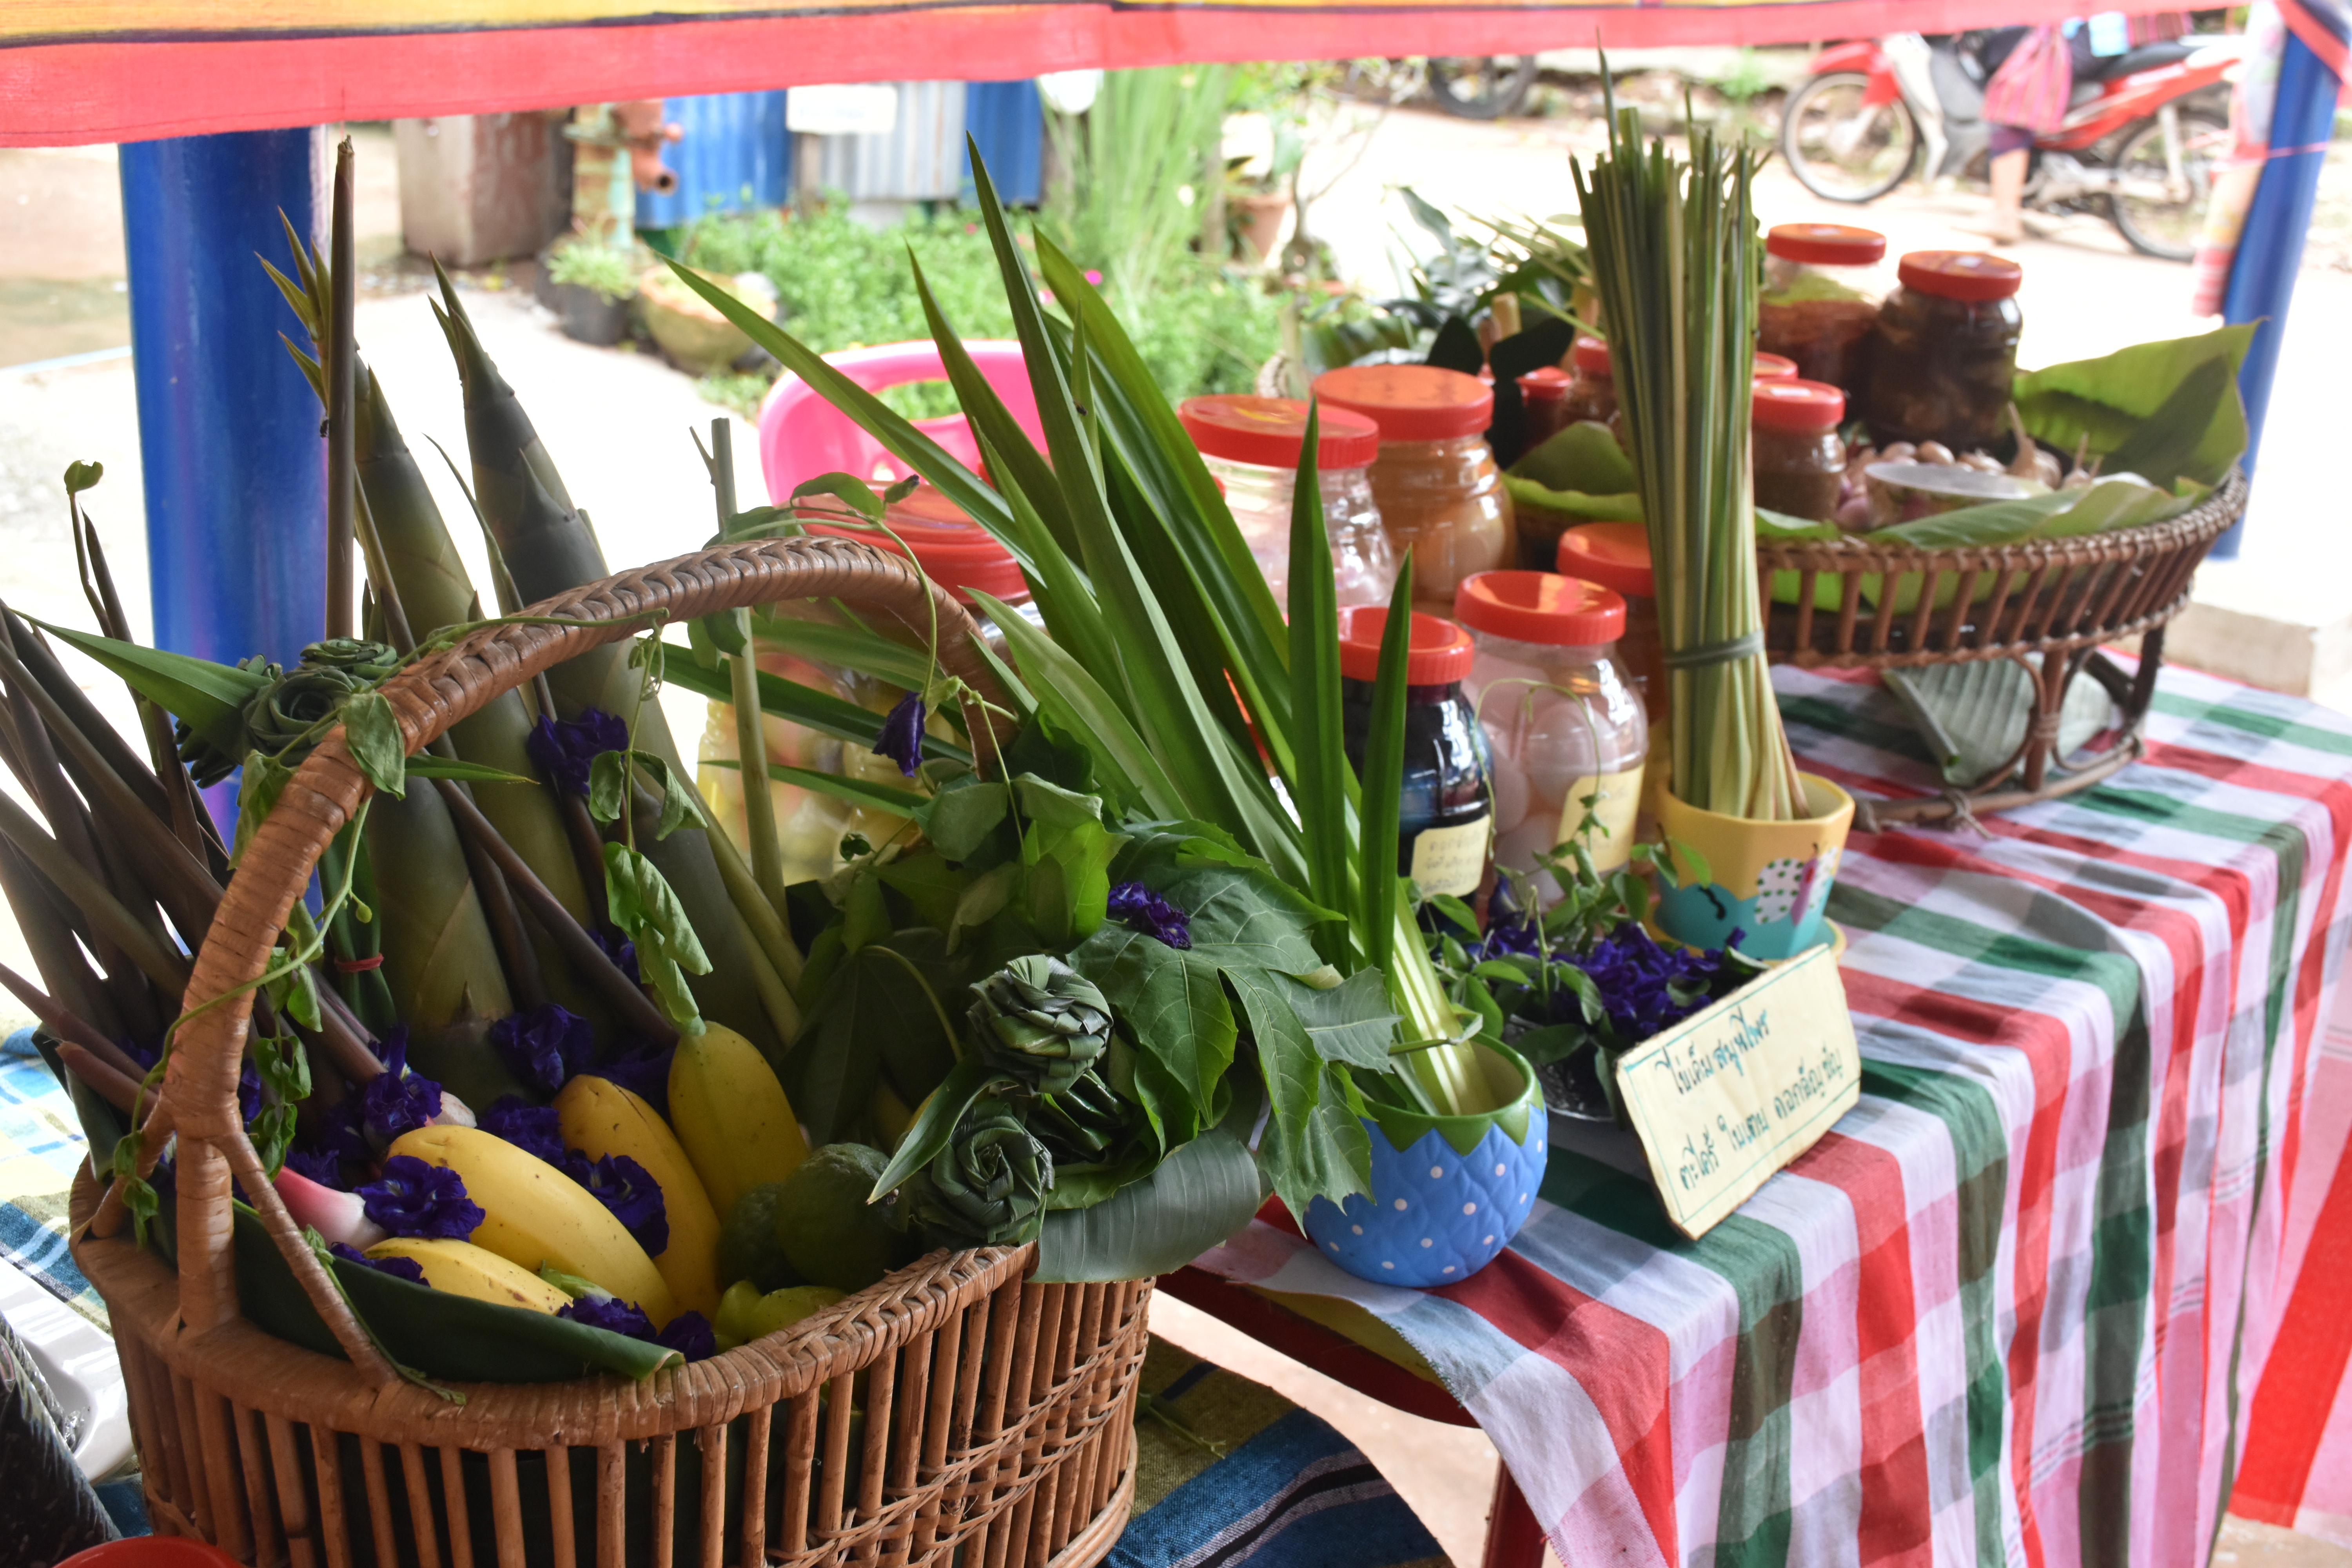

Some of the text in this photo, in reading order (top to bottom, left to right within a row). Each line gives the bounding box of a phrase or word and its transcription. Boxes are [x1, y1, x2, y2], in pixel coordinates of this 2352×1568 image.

[1680, 1125, 1719, 1191] ตะไคร้
[1717, 1107, 1770, 1151] ใบเตย
